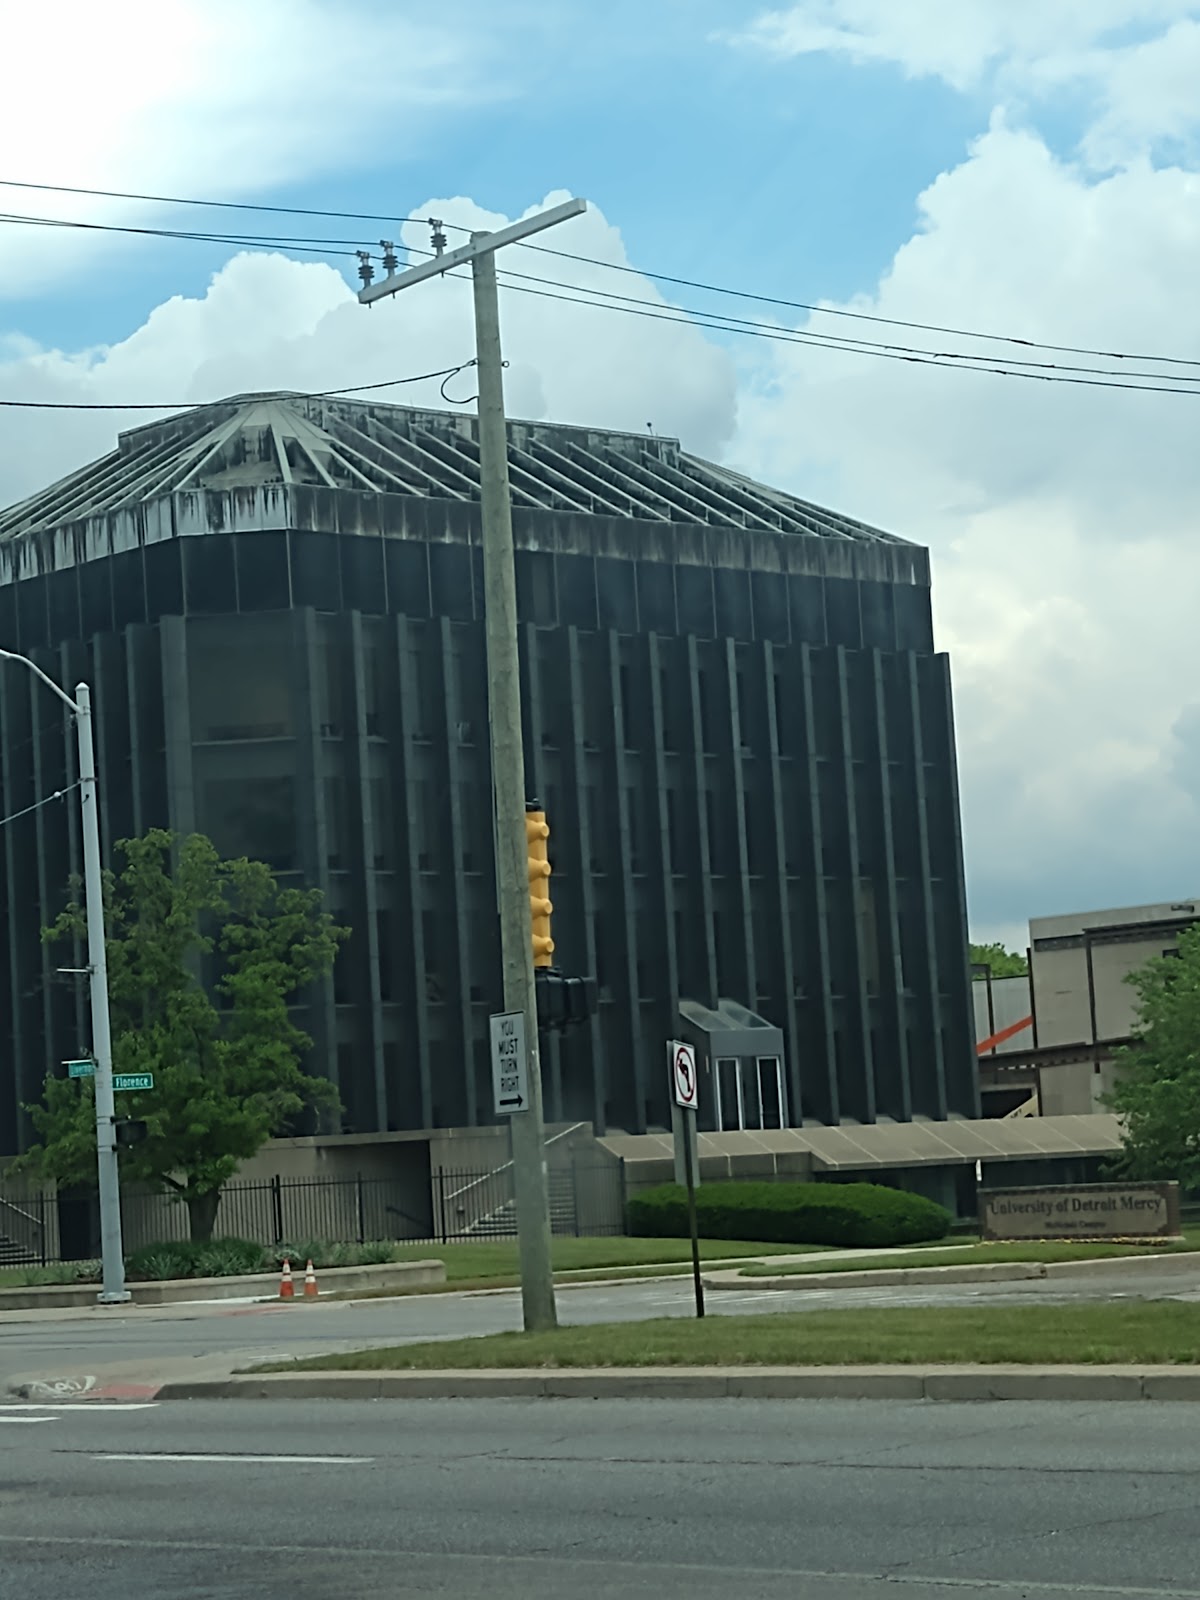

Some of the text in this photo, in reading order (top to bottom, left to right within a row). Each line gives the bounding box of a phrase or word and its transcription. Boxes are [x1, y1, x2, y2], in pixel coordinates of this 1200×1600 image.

[500, 1020, 514, 1036] YOU
[498, 1038, 518, 1055] MUST
[501, 1058, 518, 1073] TURN
[115, 1077, 149, 1088] Florence
[501, 1076, 519, 1092] RIGHT
[990, 1196, 1161, 1216] University of Detroit Mercy
